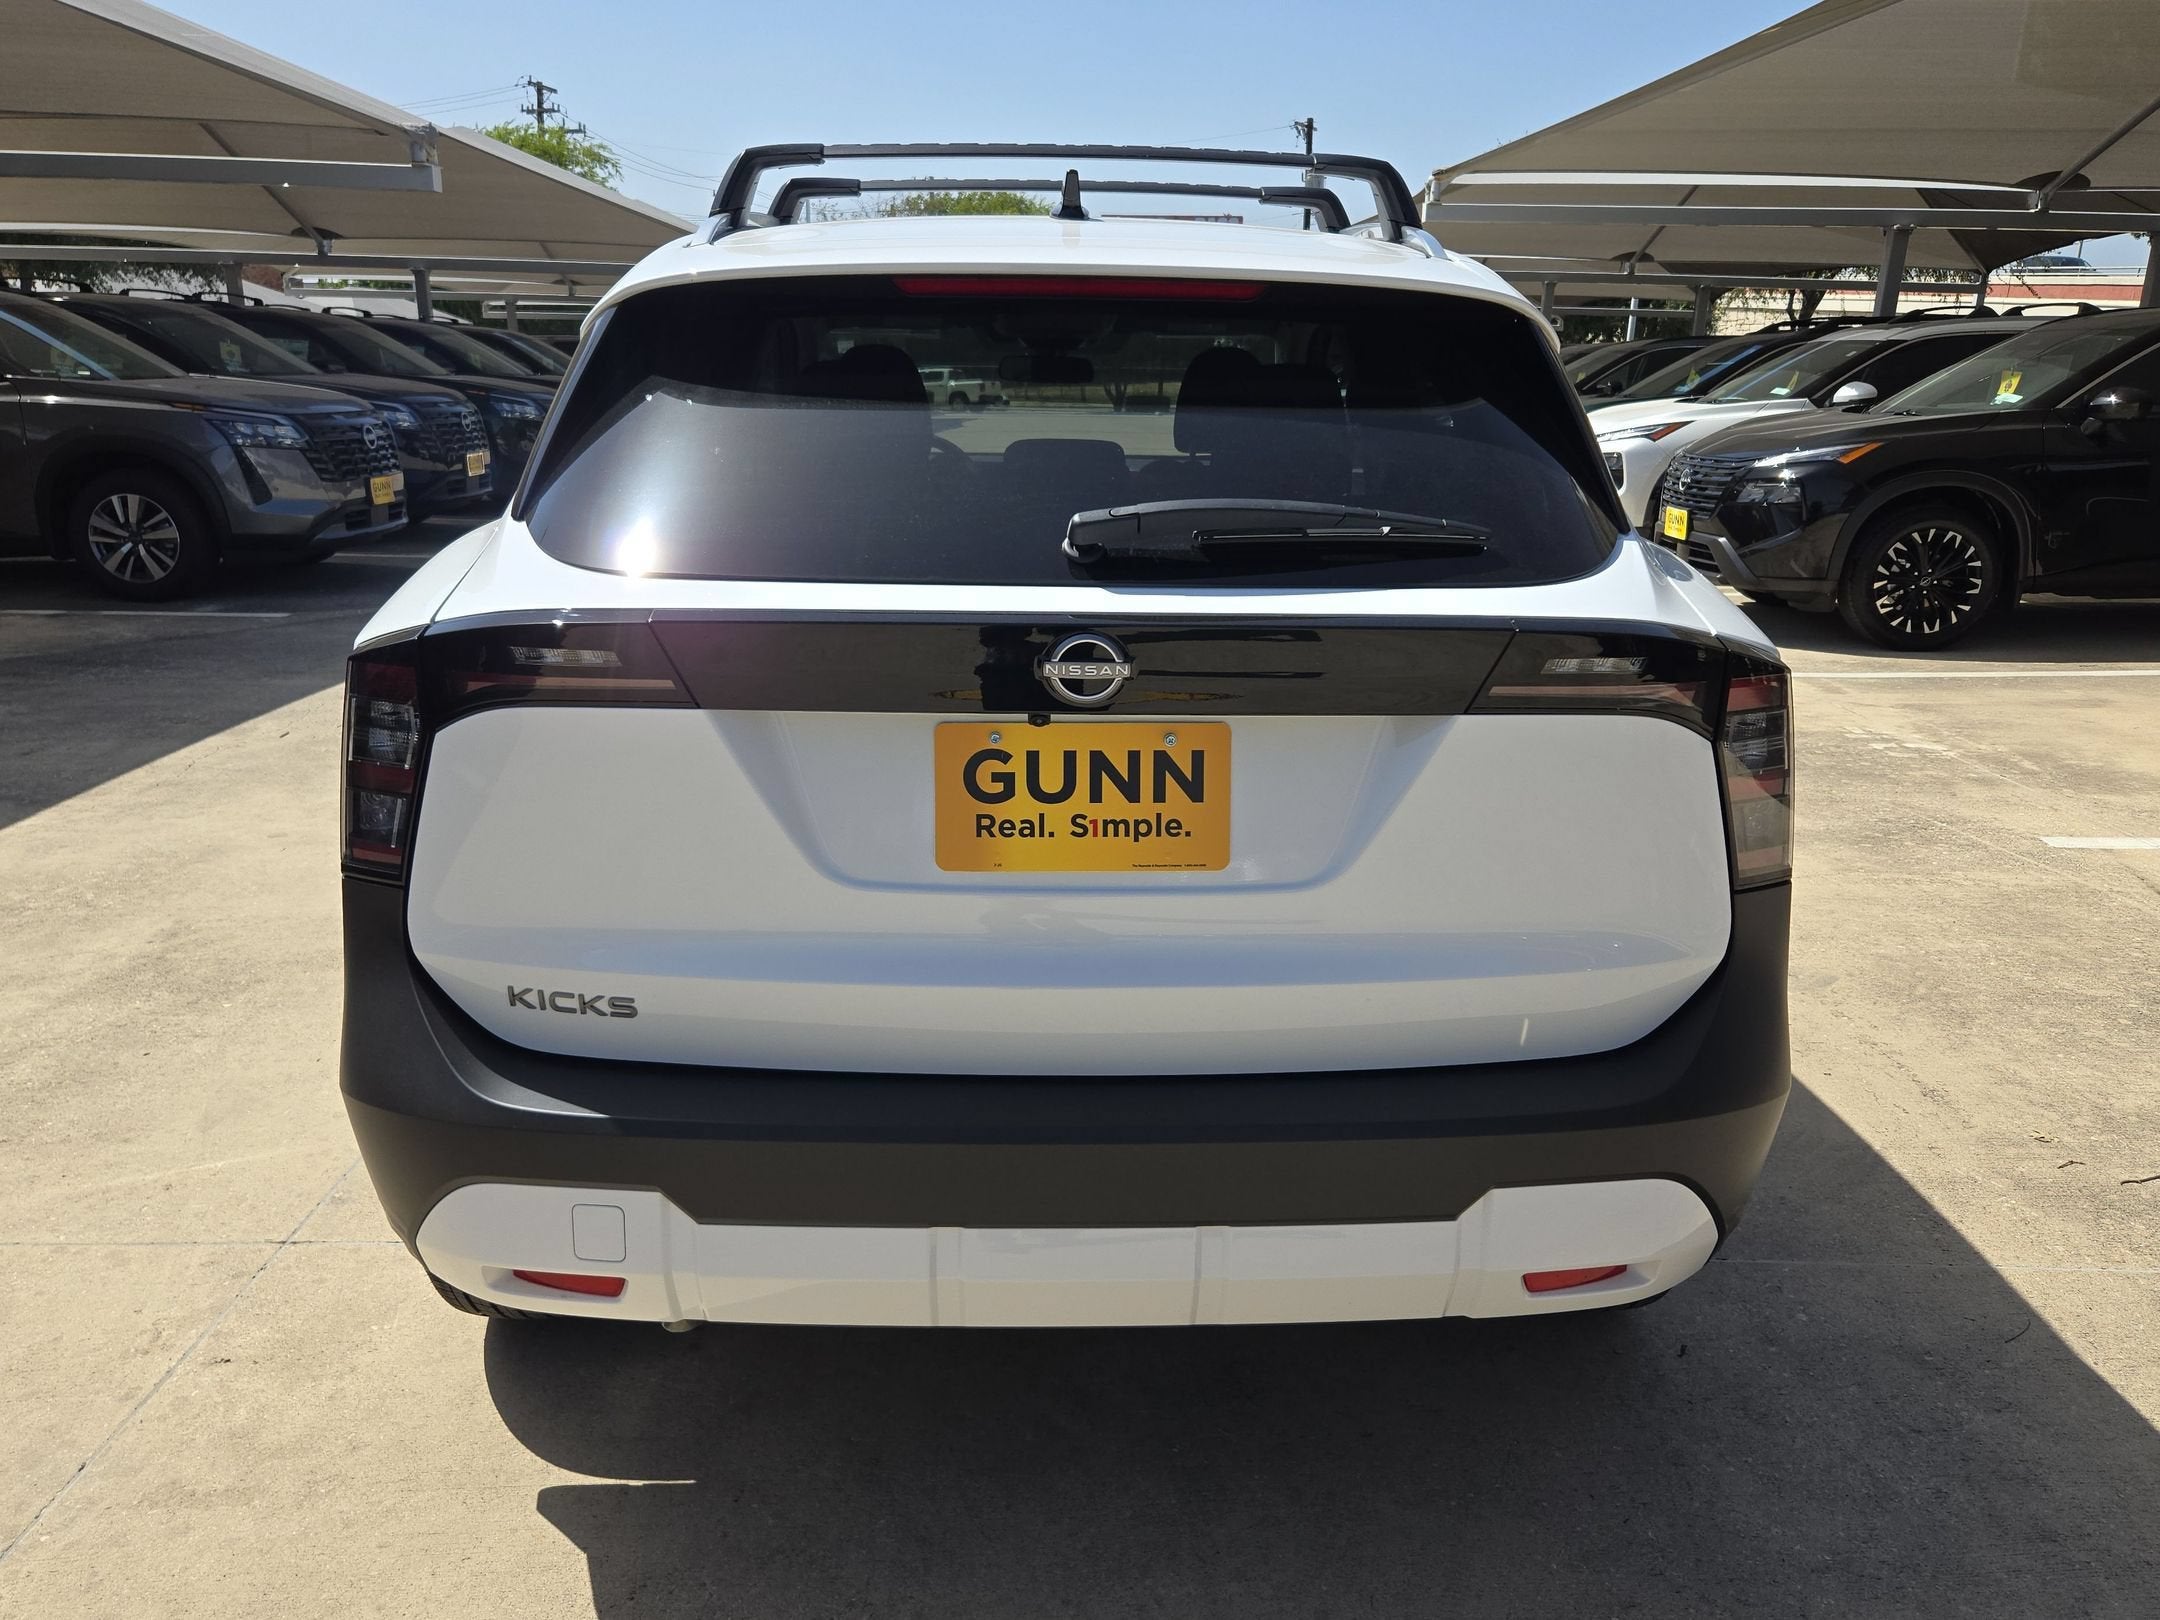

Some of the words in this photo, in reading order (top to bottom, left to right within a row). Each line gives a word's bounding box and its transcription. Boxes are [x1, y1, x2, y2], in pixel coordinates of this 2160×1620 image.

[1045, 663, 1128, 676] NISSAN
[963, 748, 1205, 805] GUNN
[975, 812, 1055, 838] Real.
[507, 985, 639, 1019] KICKS
